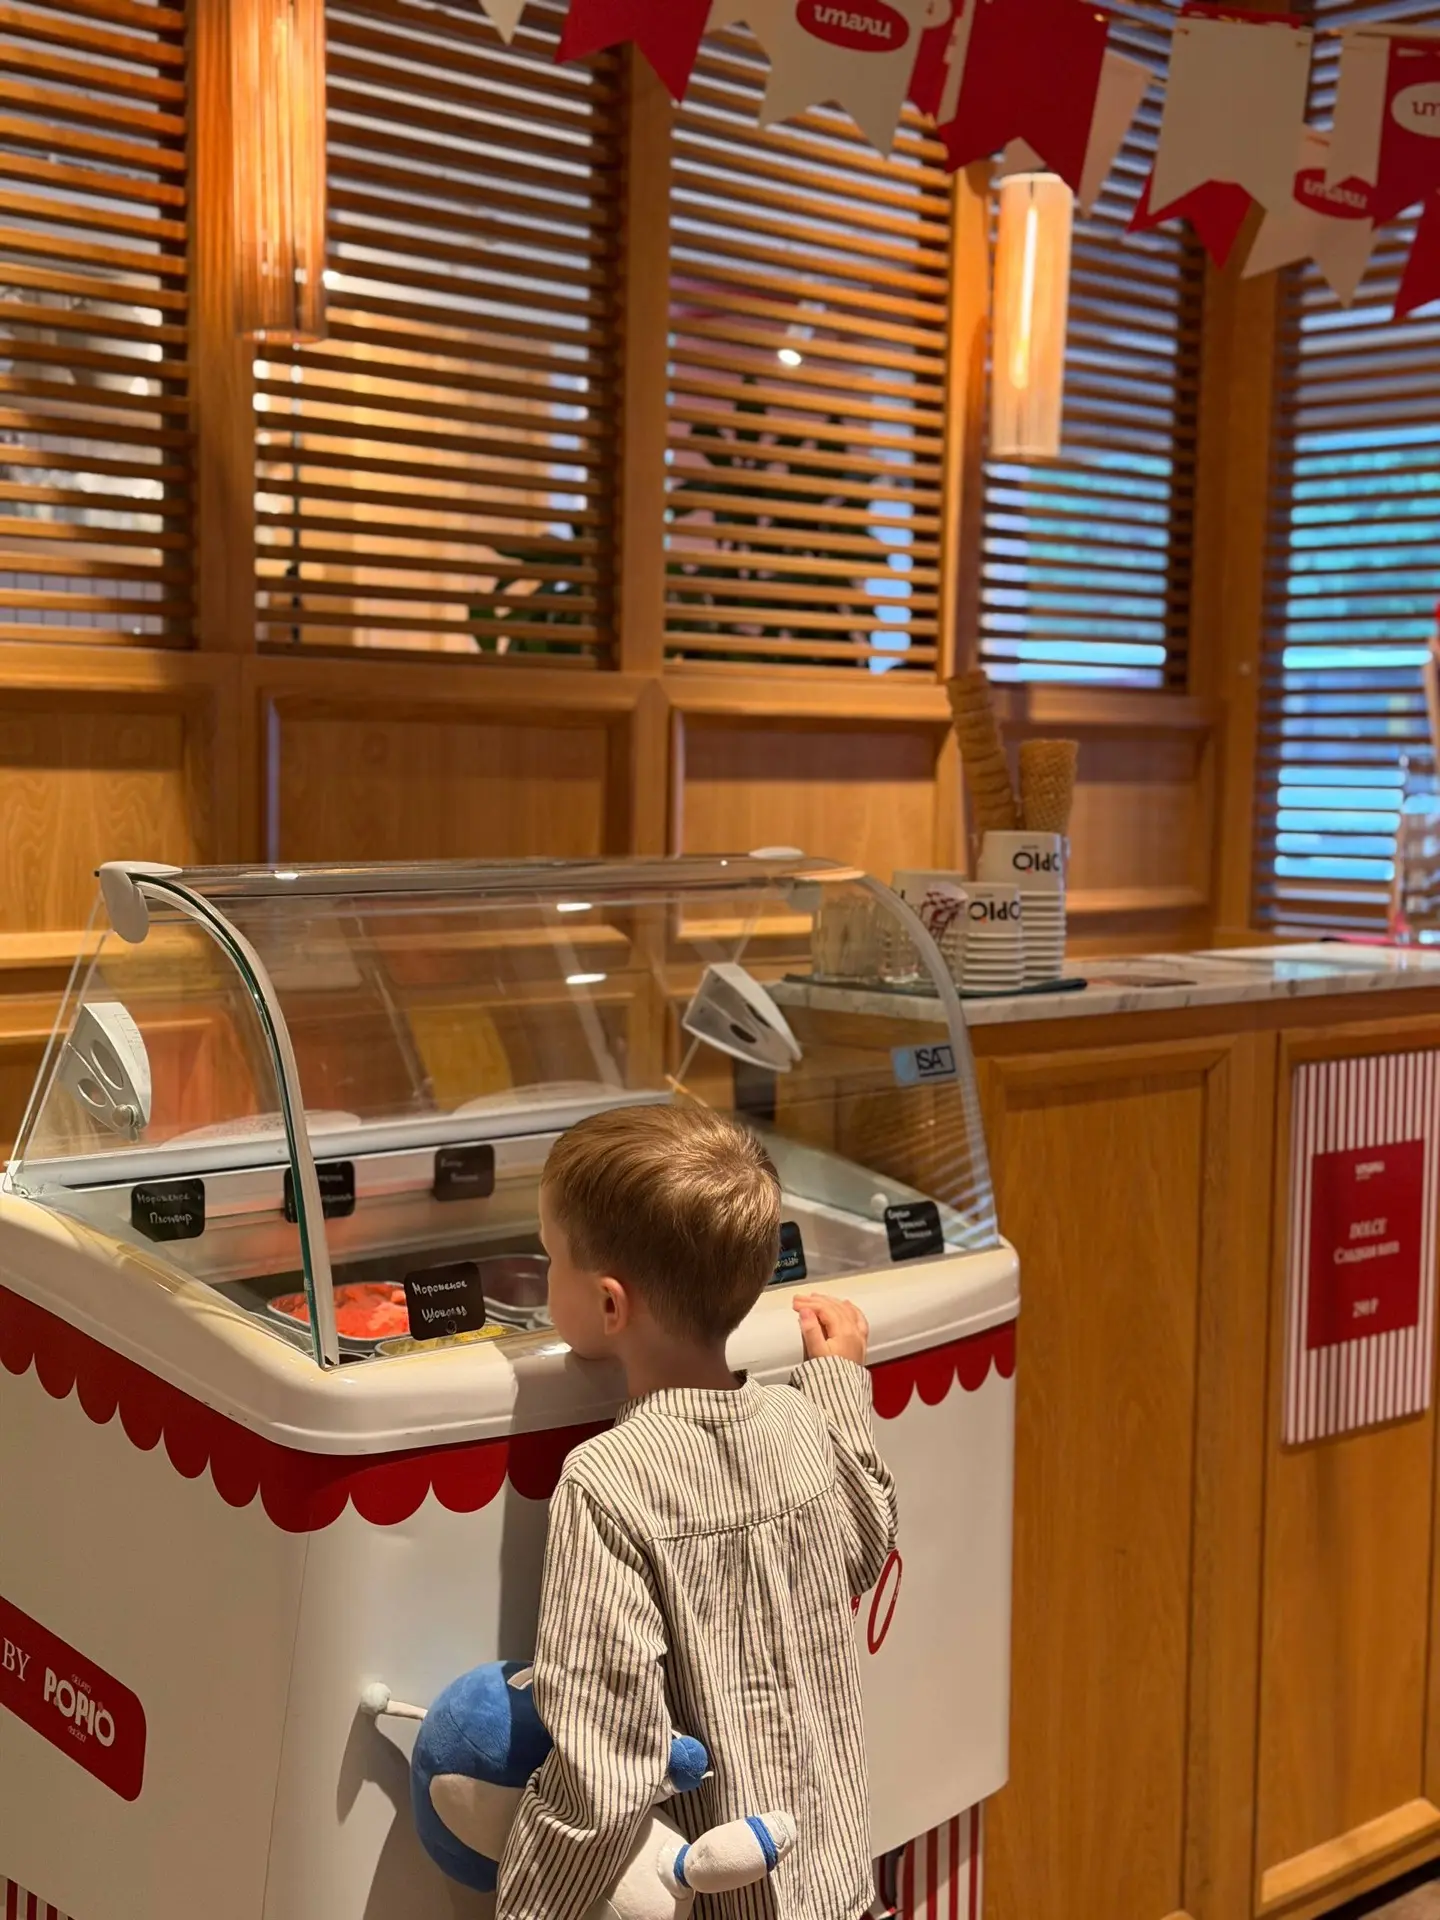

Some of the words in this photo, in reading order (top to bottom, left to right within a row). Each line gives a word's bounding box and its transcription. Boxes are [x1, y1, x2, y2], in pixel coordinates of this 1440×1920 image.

[813, 4, 891, 39] umaru
[1411, 101, 1440, 117] um
[914, 1046, 945, 1070] ISA
[411, 1280, 468, 1297] Мороженое
[2, 1637, 31, 1681] BY
[43, 1666, 115, 1747] POPIO
